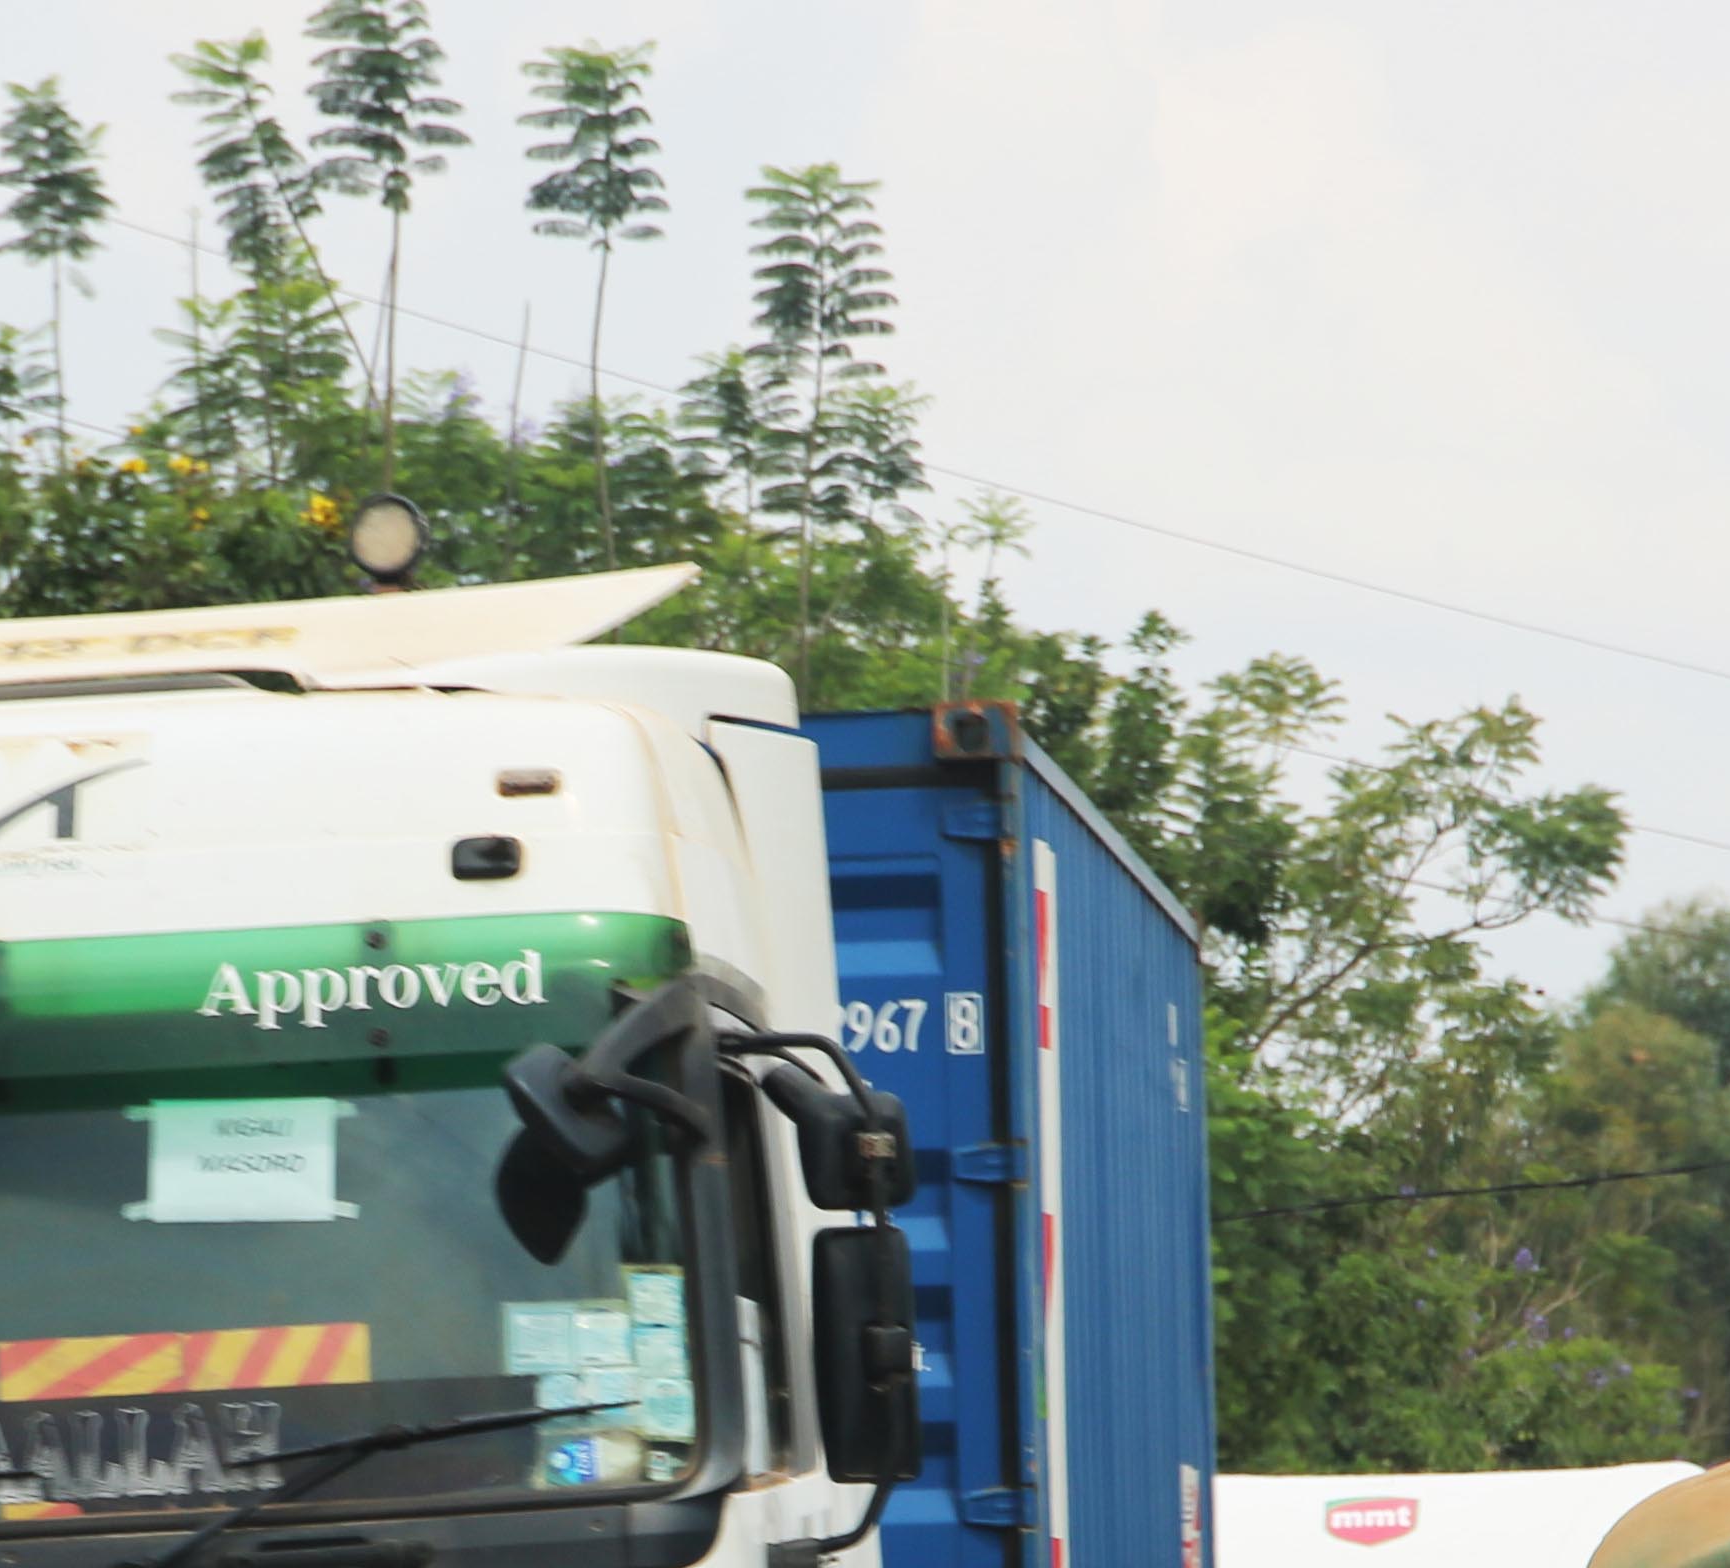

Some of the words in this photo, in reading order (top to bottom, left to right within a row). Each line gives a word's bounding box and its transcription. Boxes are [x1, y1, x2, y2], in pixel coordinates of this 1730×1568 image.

[195, 949, 549, 1030] Approved
[837, 999, 928, 1053] 967
[1331, 1504, 1412, 1529] mmt
